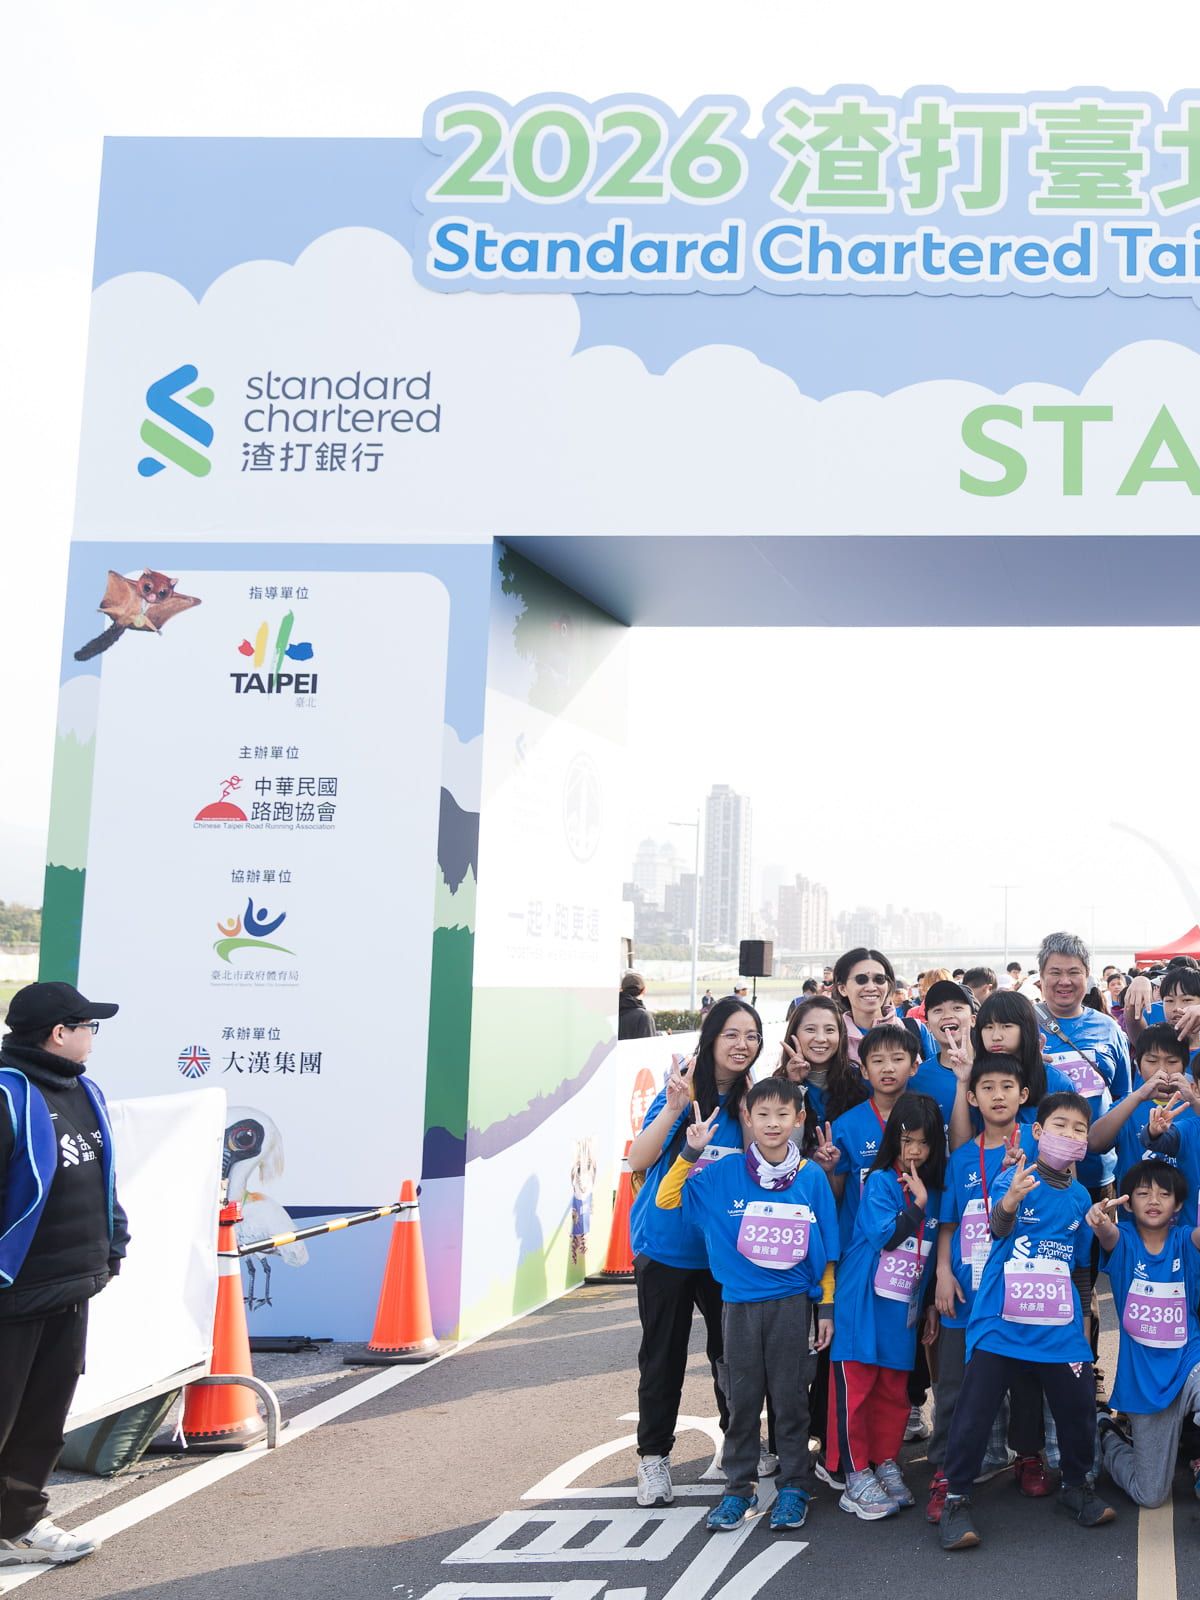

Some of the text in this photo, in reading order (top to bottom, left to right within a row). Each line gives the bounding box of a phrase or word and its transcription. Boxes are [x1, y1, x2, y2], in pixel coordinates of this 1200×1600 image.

[433, 108, 744, 200] 2026
[432, 223, 739, 275] Standard
[758, 225, 1092, 277] Chartered
[245, 370, 431, 400] standard
[244, 403, 441, 433] chartered
[241, 441, 384, 472] 渣打銀行
[249, 586, 309, 600] 指導單位
[230, 673, 318, 694] TAIPEI
[239, 745, 299, 759] 主辦單位
[255, 776, 337, 797] 中華民國
[251, 801, 336, 822] 路跑協會
[193, 822, 221, 830] Chinese
[223, 822, 244, 831] Taipei
[266, 823, 294, 831] Running
[295, 823, 335, 831] Association
[231, 869, 292, 883] 協辦單位
[221, 1027, 281, 1041] 承辦單位
[222, 1051, 323, 1075] 大漢集團
[743, 1224, 805, 1246] 32393
[1010, 1282, 1066, 1301] 32391
[1128, 1302, 1183, 1324] 32380
